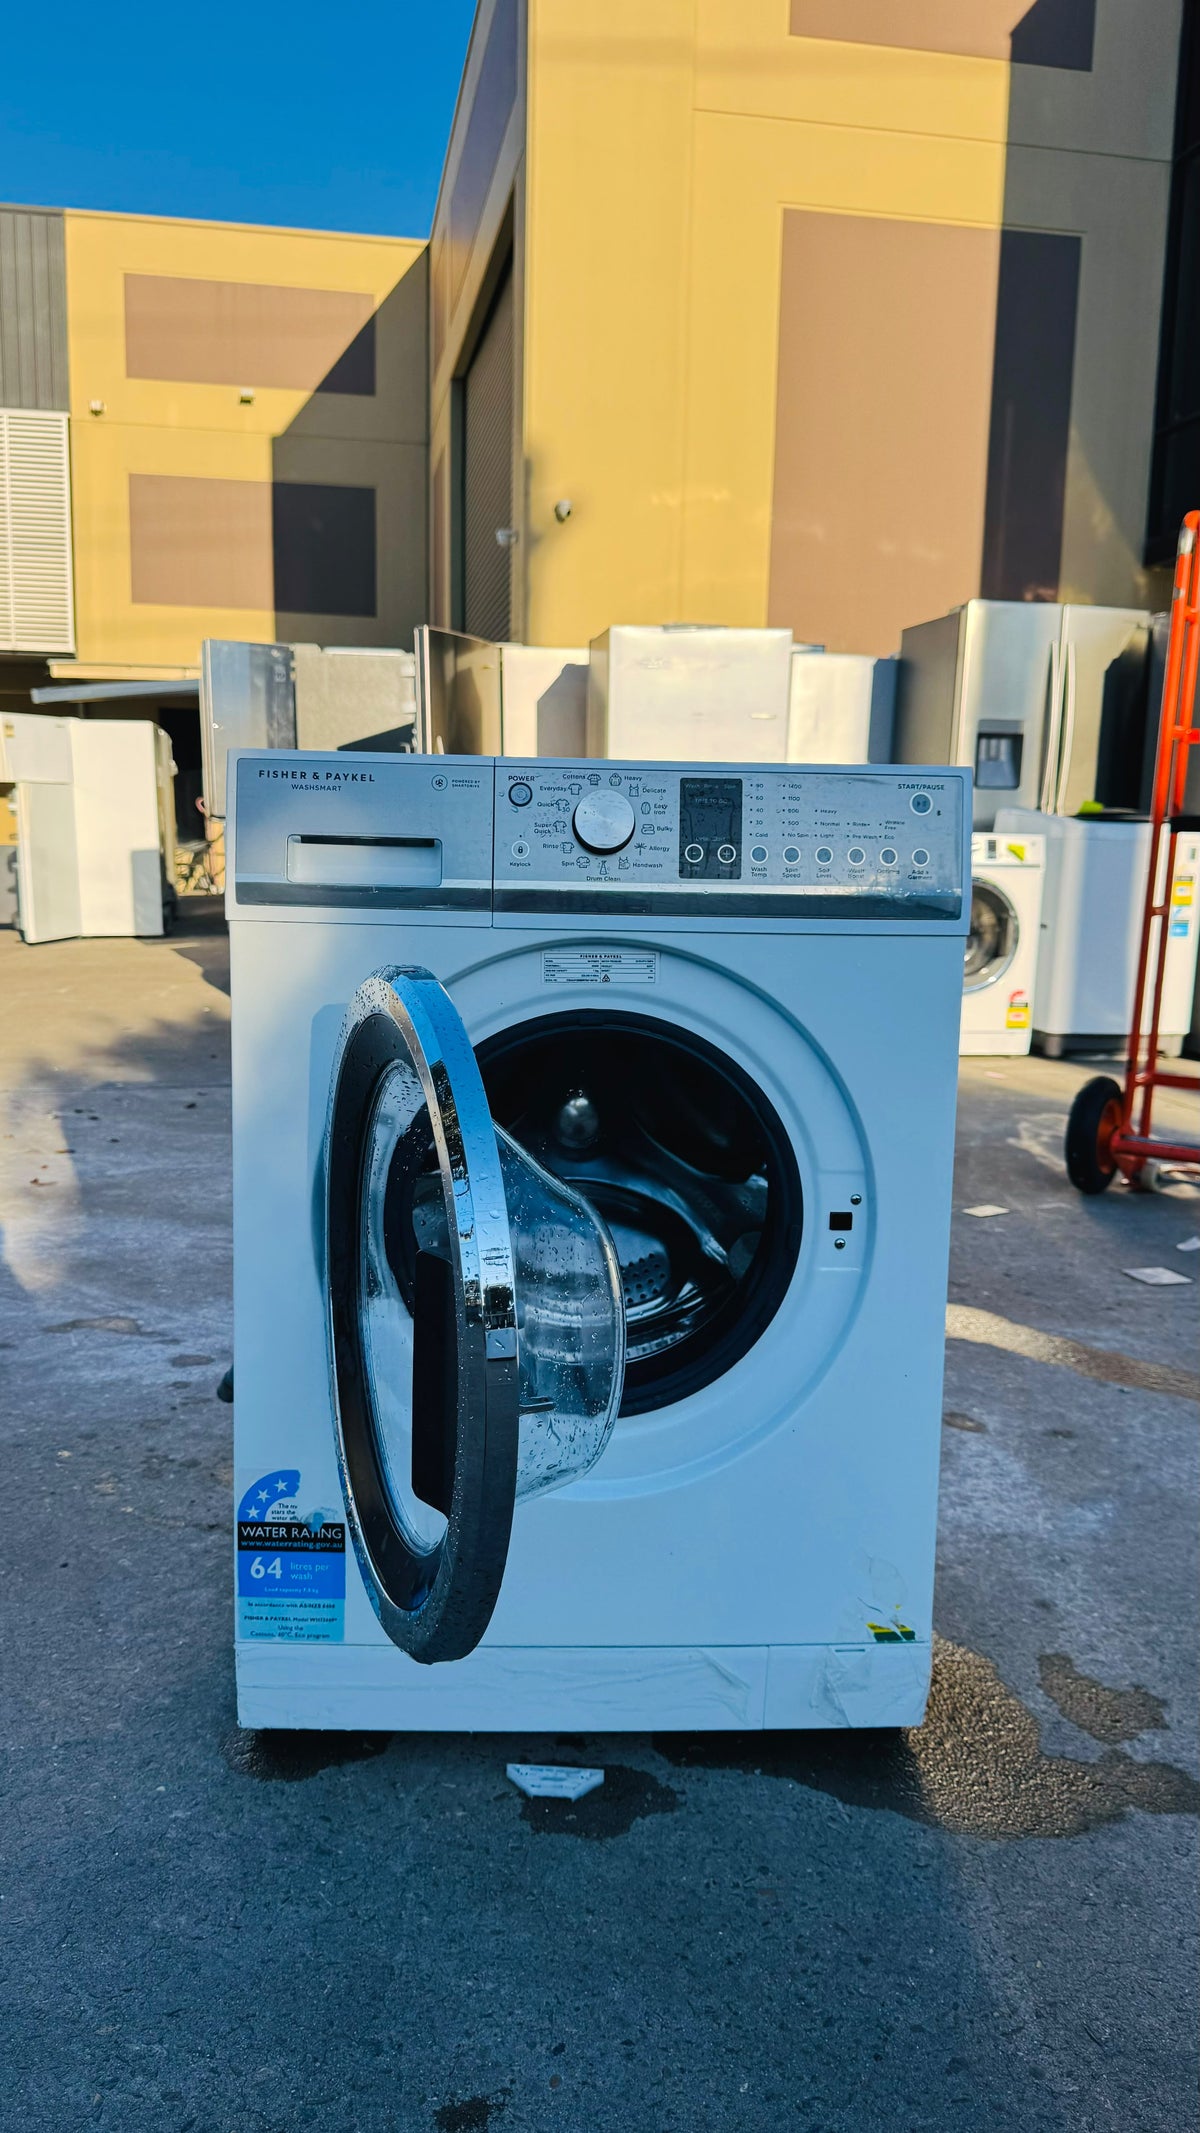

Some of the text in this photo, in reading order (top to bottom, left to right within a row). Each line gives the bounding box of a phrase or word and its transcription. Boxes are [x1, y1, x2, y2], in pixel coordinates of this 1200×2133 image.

[258, 769, 376, 782] FISHER & PAYKEL
[291, 783, 342, 792] WASHSMART
[241, 1526, 288, 1538] WATER
[241, 1540, 343, 1549] www.waterrating.gov.au
[250, 1556, 282, 1579] 64
[290, 1562, 329, 1572] litres per
[290, 1572, 313, 1580] wash
